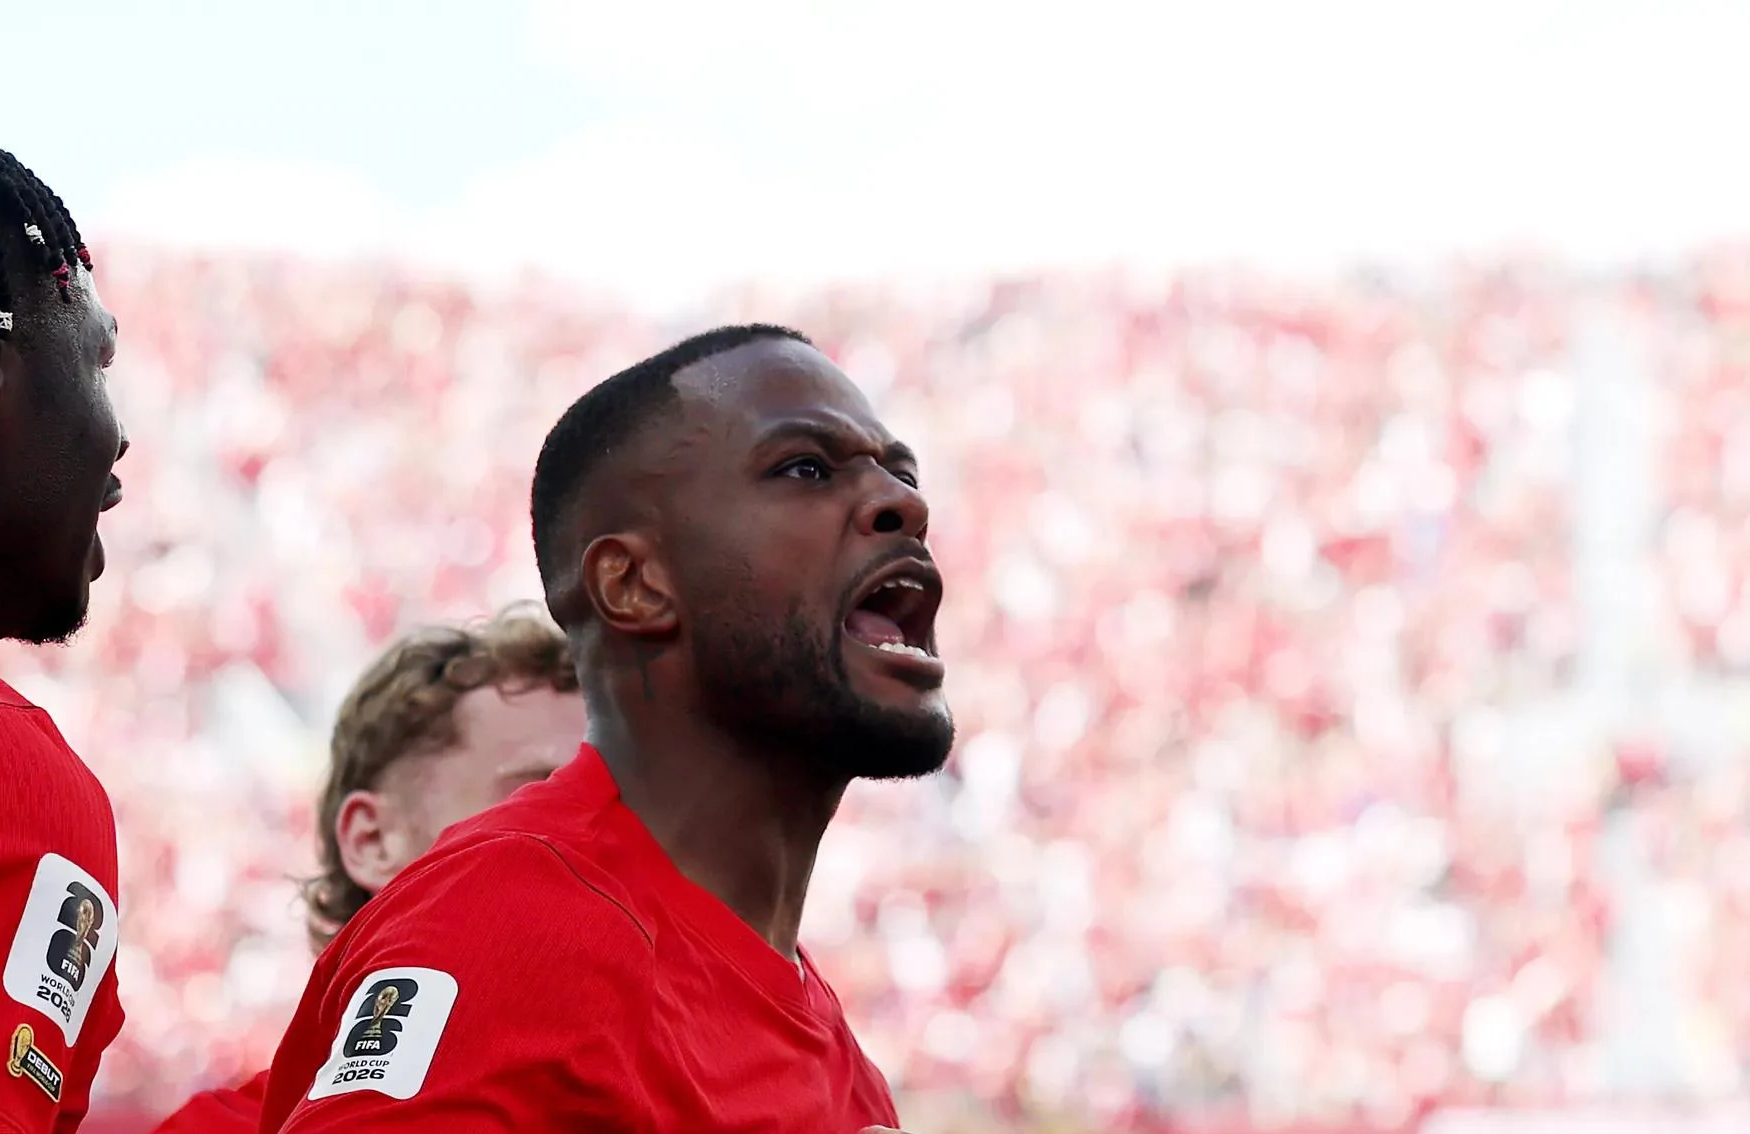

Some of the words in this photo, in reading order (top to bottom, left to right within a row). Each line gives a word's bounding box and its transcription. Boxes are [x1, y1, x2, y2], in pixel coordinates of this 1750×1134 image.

[61, 958, 80, 982] FIFA
[37, 985, 72, 1023] 2026
[355, 1040, 380, 1050] FIFA
[27, 1050, 60, 1086] DEBUT
[332, 1069, 385, 1085] 2026
